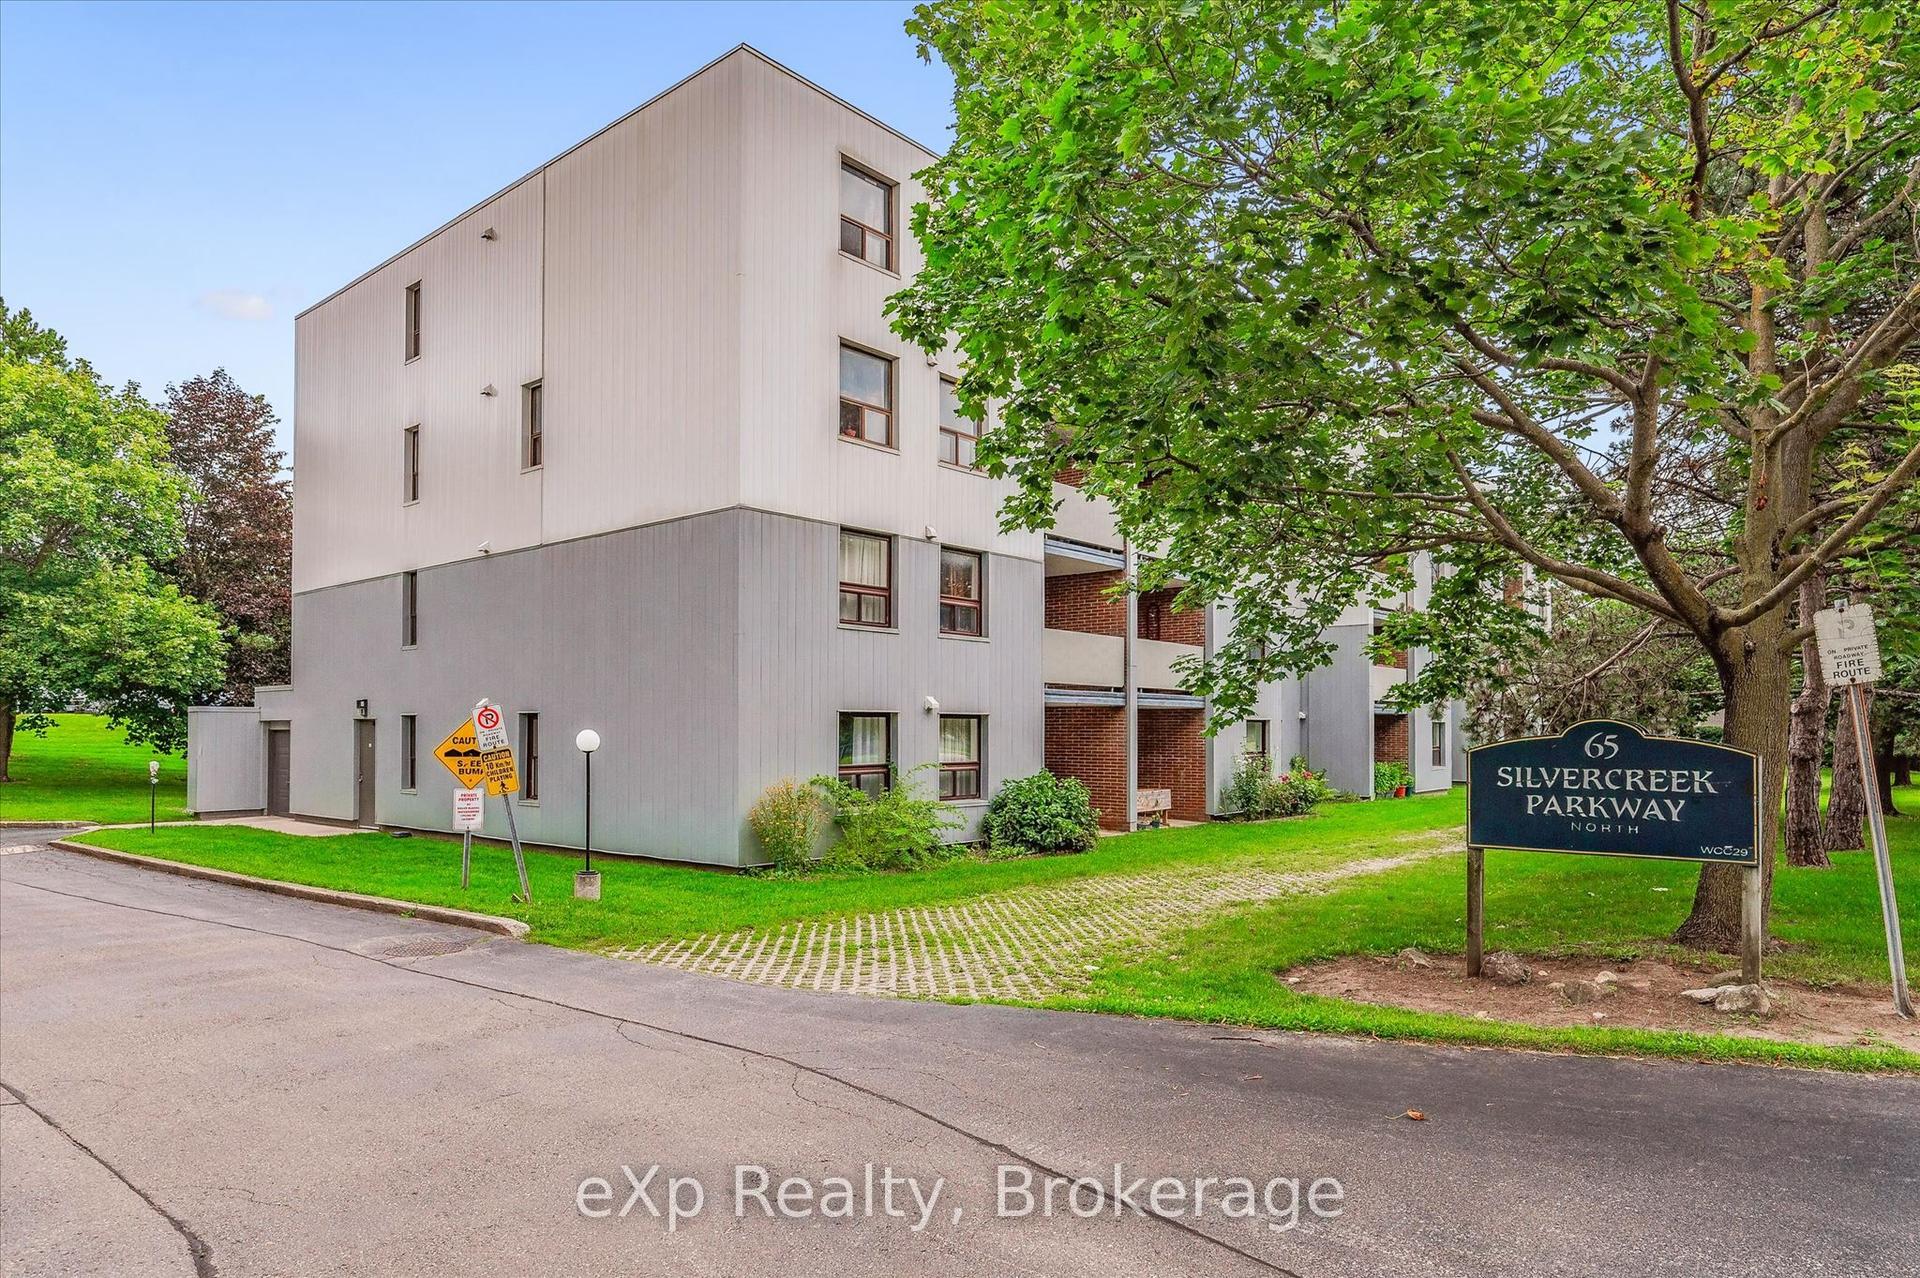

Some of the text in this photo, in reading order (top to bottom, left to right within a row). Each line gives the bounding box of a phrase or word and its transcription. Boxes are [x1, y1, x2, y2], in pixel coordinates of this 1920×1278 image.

[1843, 644, 1868, 652] PRIVATE
[1833, 651, 1864, 660] ROADWAY
[1836, 658, 1865, 669] FIRE
[1833, 667, 1871, 679] ROUTE
[483, 739, 504, 748] ROUTE
[1584, 731, 1619, 760] 65
[482, 750, 511, 761] CAUTION
[487, 767, 513, 777] CHILDREN
[489, 773, 512, 782] PLAYING
[1496, 766, 1719, 794] SILVERCREEK
[1525, 794, 1686, 822] PARKWAY
[1570, 822, 1639, 834] NORTH
